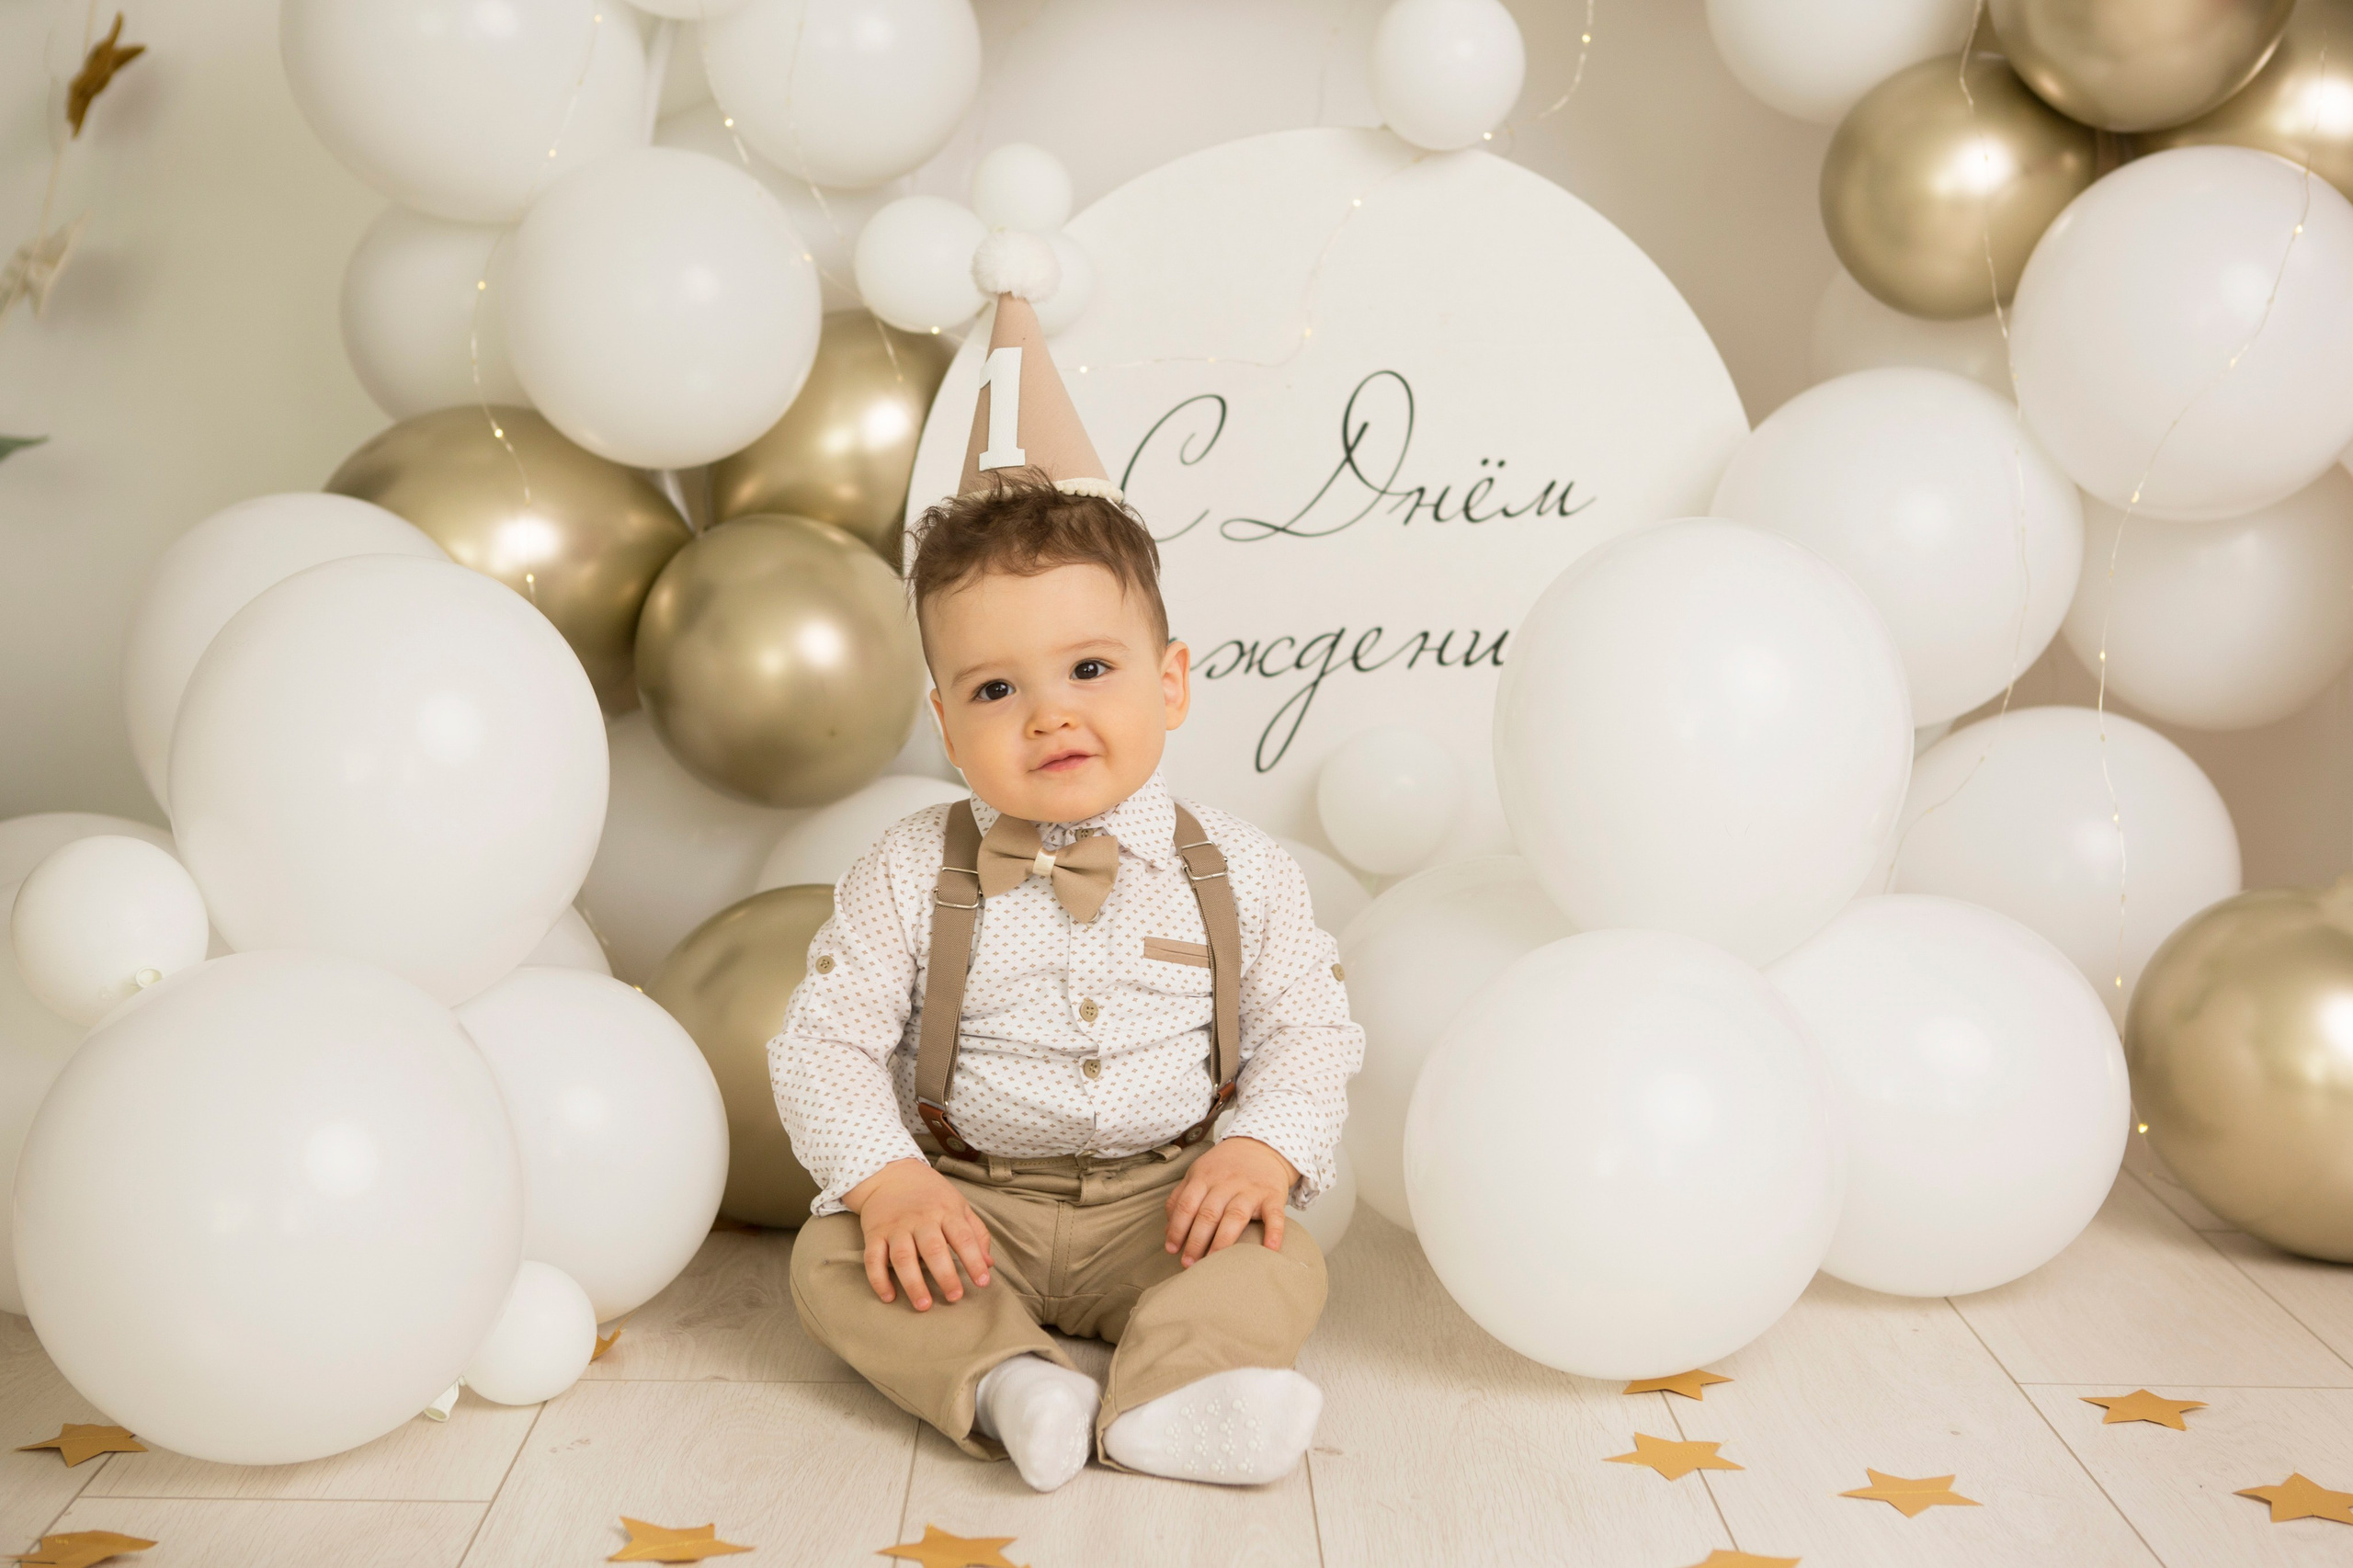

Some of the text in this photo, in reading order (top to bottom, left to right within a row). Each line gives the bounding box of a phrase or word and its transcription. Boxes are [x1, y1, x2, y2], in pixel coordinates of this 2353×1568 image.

[979, 347, 1026, 472] 1
[1120, 369, 1597, 543] С Днём
[1168, 627, 1510, 774] ждени
